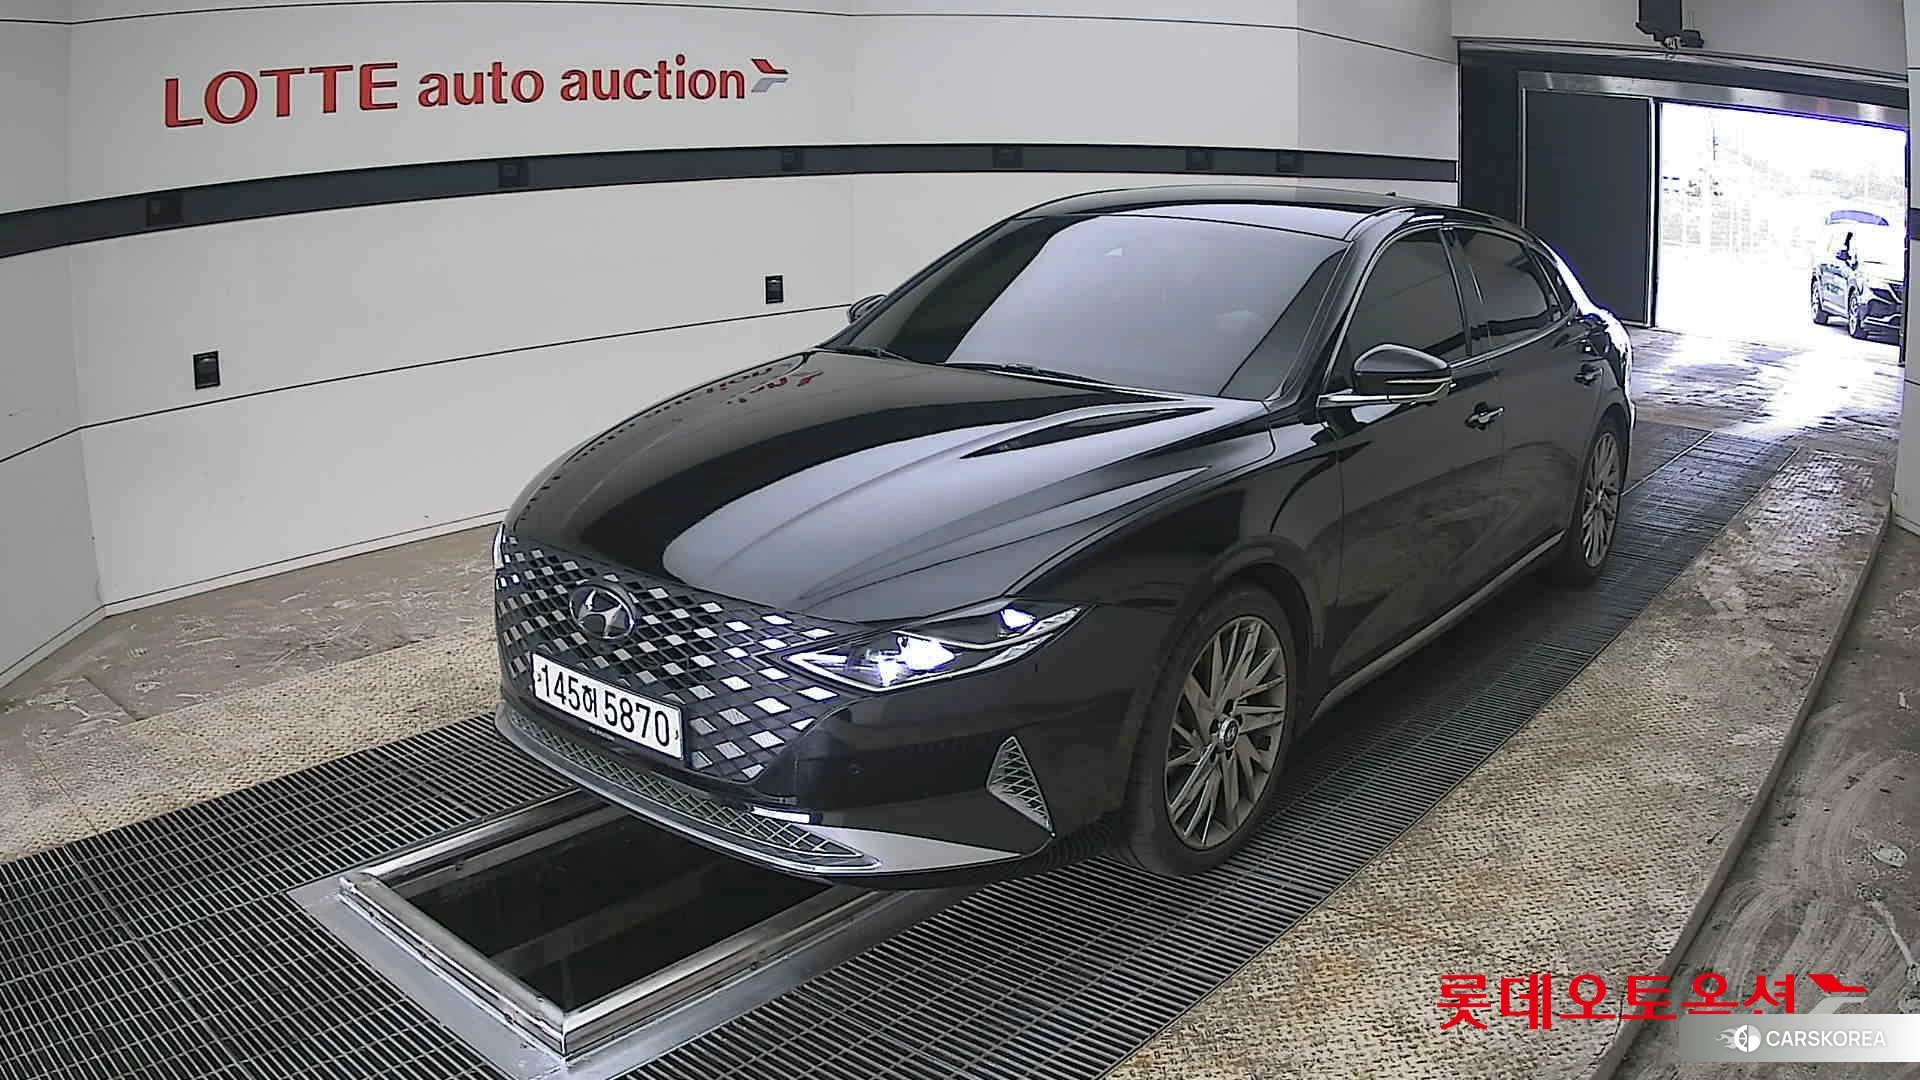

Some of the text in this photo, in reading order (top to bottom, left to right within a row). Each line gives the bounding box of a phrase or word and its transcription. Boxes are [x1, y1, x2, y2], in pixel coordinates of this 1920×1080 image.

[164, 54, 747, 128] LOTTE auto auction
[604, 690, 670, 747] 5870
